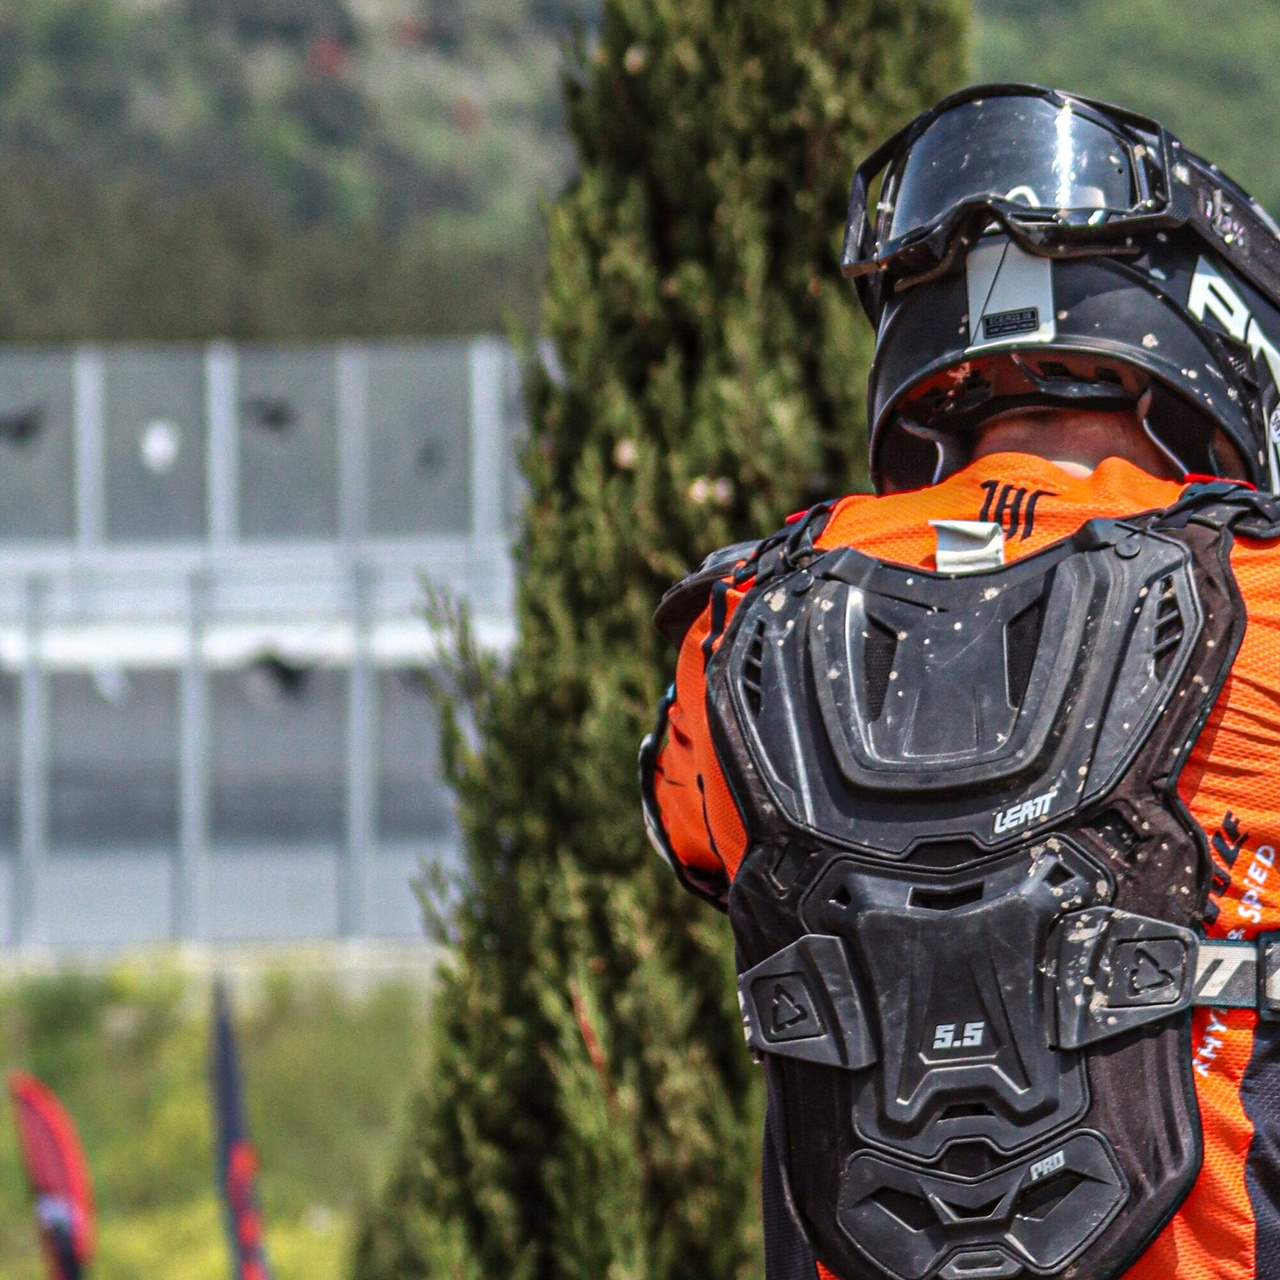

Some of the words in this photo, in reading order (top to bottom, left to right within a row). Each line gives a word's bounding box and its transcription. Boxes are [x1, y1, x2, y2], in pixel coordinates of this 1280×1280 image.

[994, 790, 1058, 834] LEATT
[933, 1021, 985, 1049] 5.5
[1030, 1150, 1065, 1181] PRO
